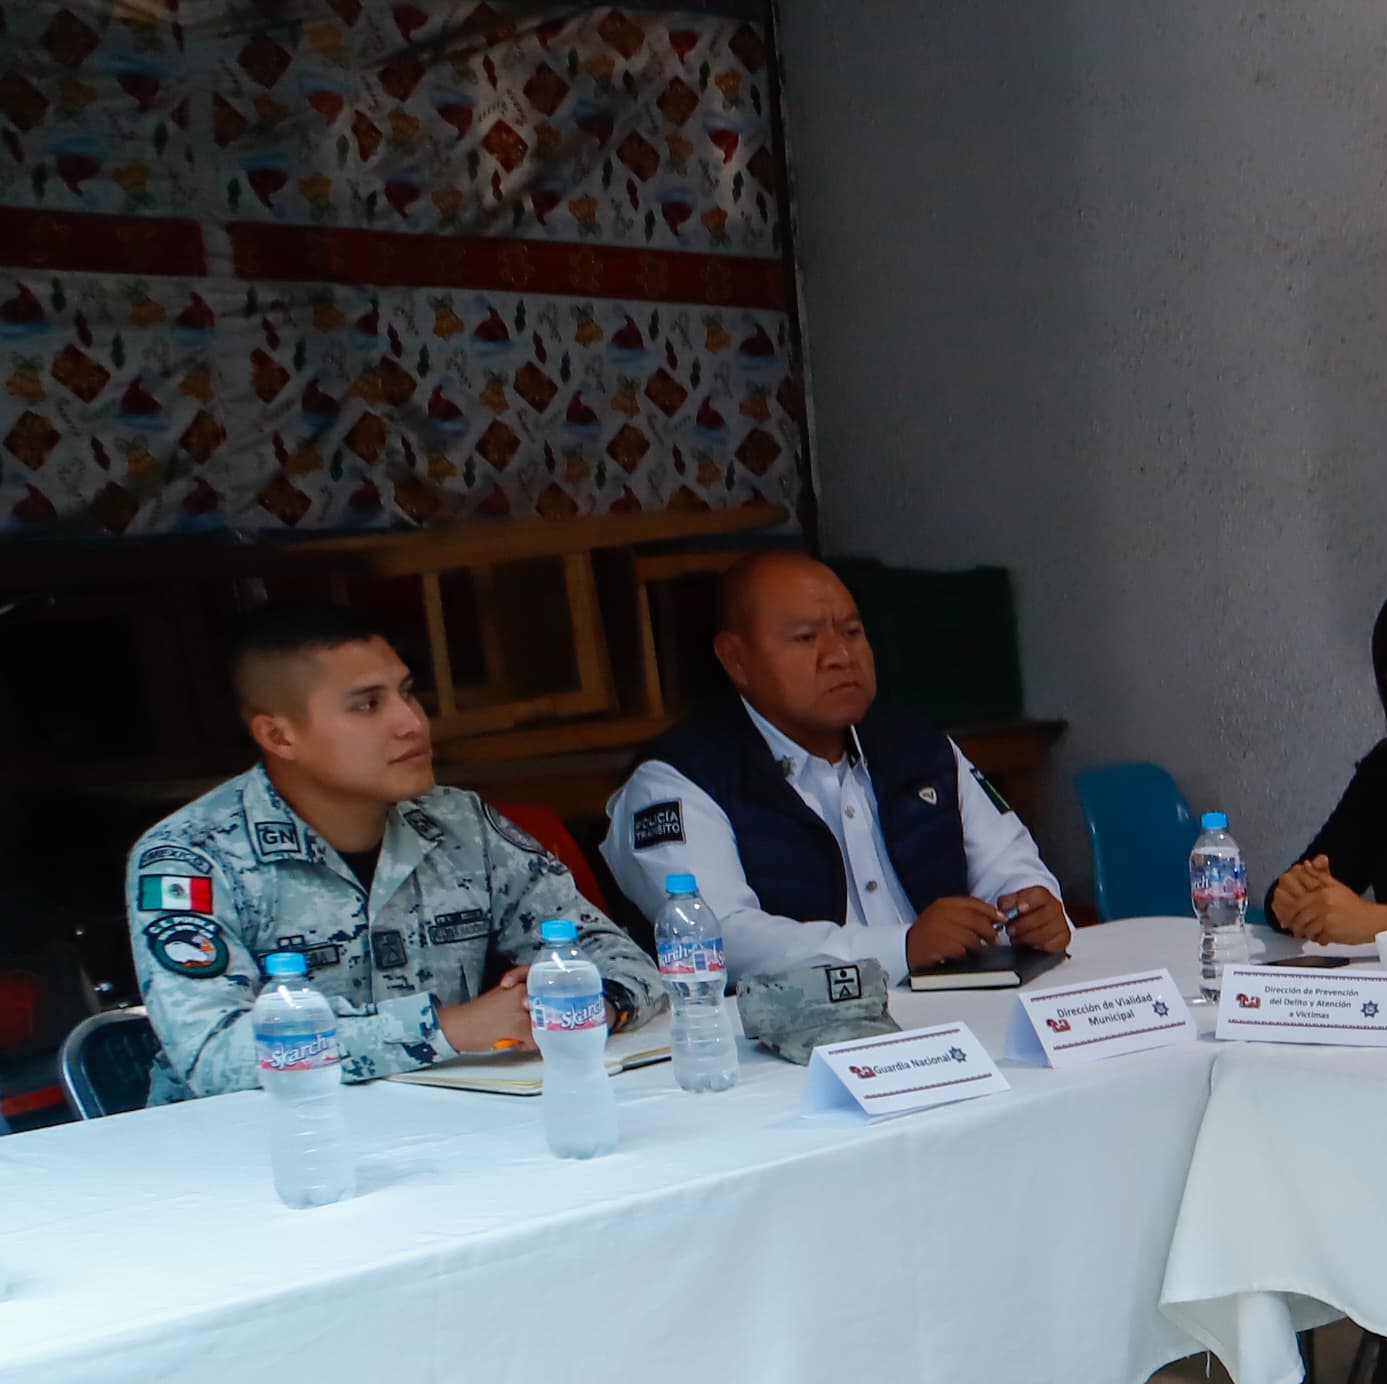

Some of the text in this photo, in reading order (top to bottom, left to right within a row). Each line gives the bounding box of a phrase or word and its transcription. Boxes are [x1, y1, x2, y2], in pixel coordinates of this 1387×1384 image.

[262, 829, 295, 845] GN
[1264, 985, 1359, 998] Dirección de Prevención
[1056, 992, 1153, 1019] Dirección de Vialidad
[1269, 997, 1282, 1007] del
[1284, 998, 1308, 1008] Delito
[1316, 998, 1352, 1009] Atención
[1088, 1009, 1136, 1027] Municipal
[873, 1052, 951, 1075] Guardia Nacional
